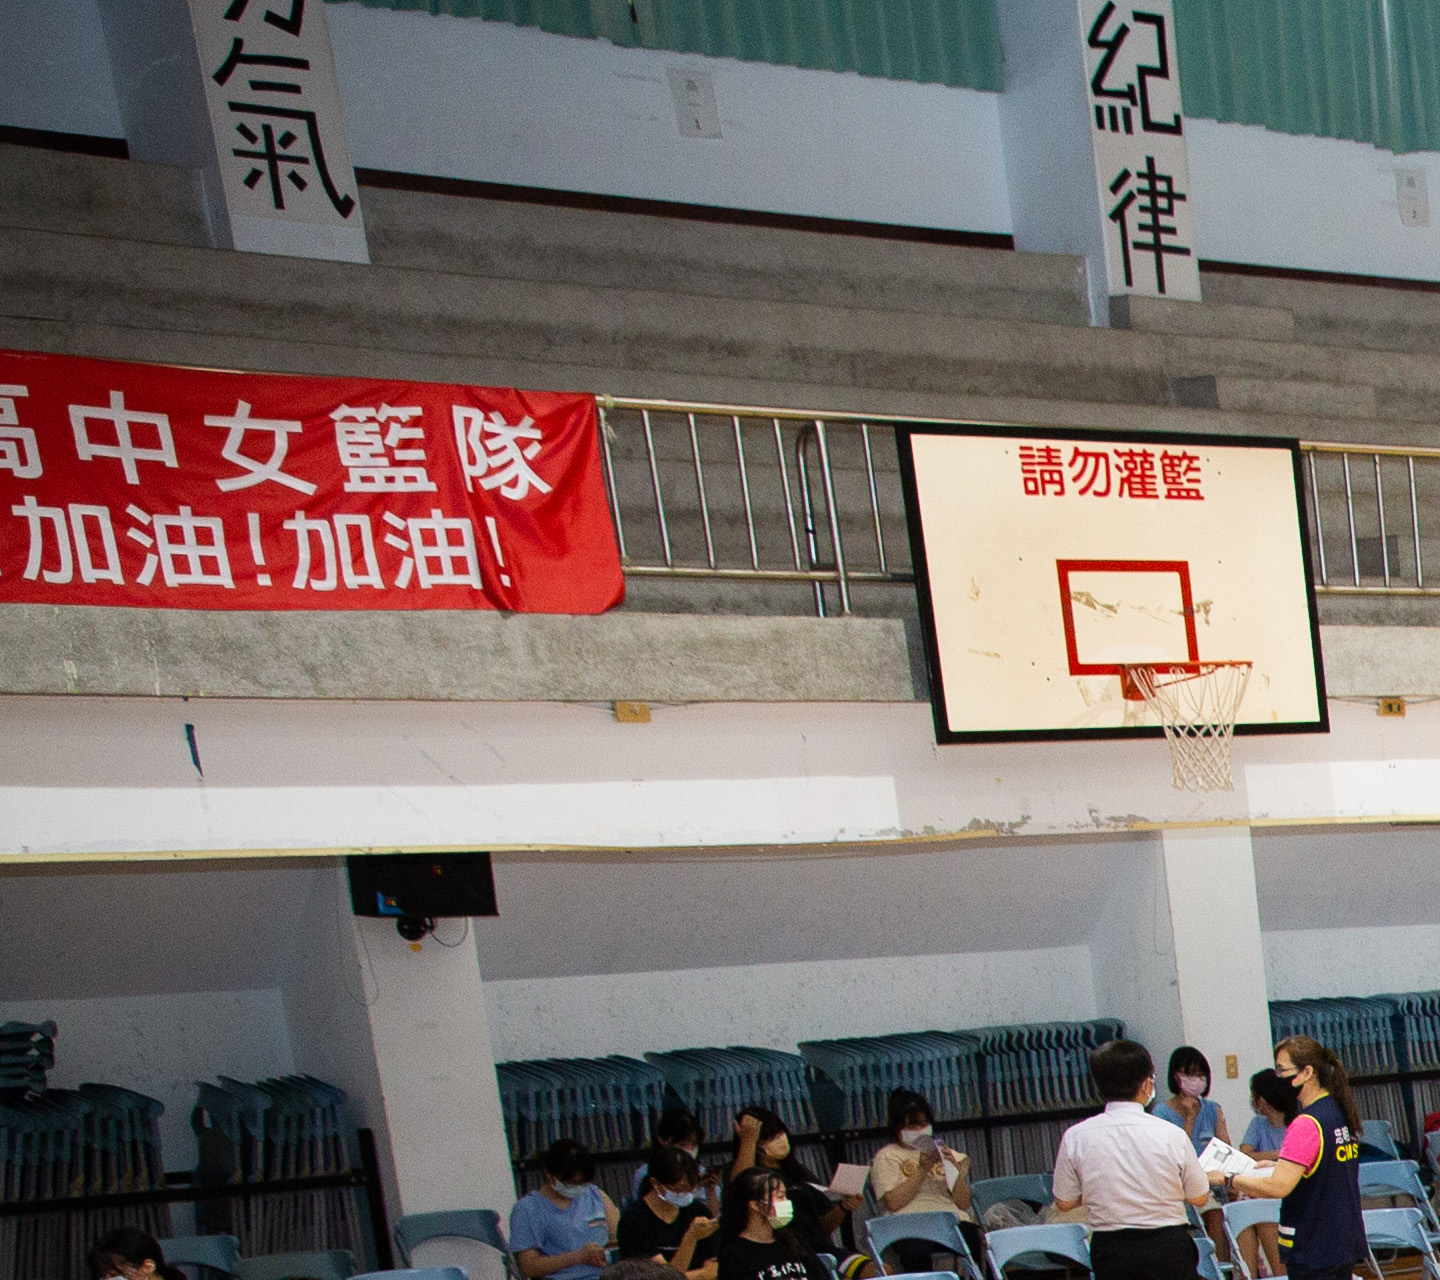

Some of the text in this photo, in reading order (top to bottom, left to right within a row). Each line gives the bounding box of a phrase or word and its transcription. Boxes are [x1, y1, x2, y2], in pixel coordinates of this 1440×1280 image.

[1087, 1, 1191, 294] 紀律
[1019, 445, 1205, 502] 請勿灌籃
